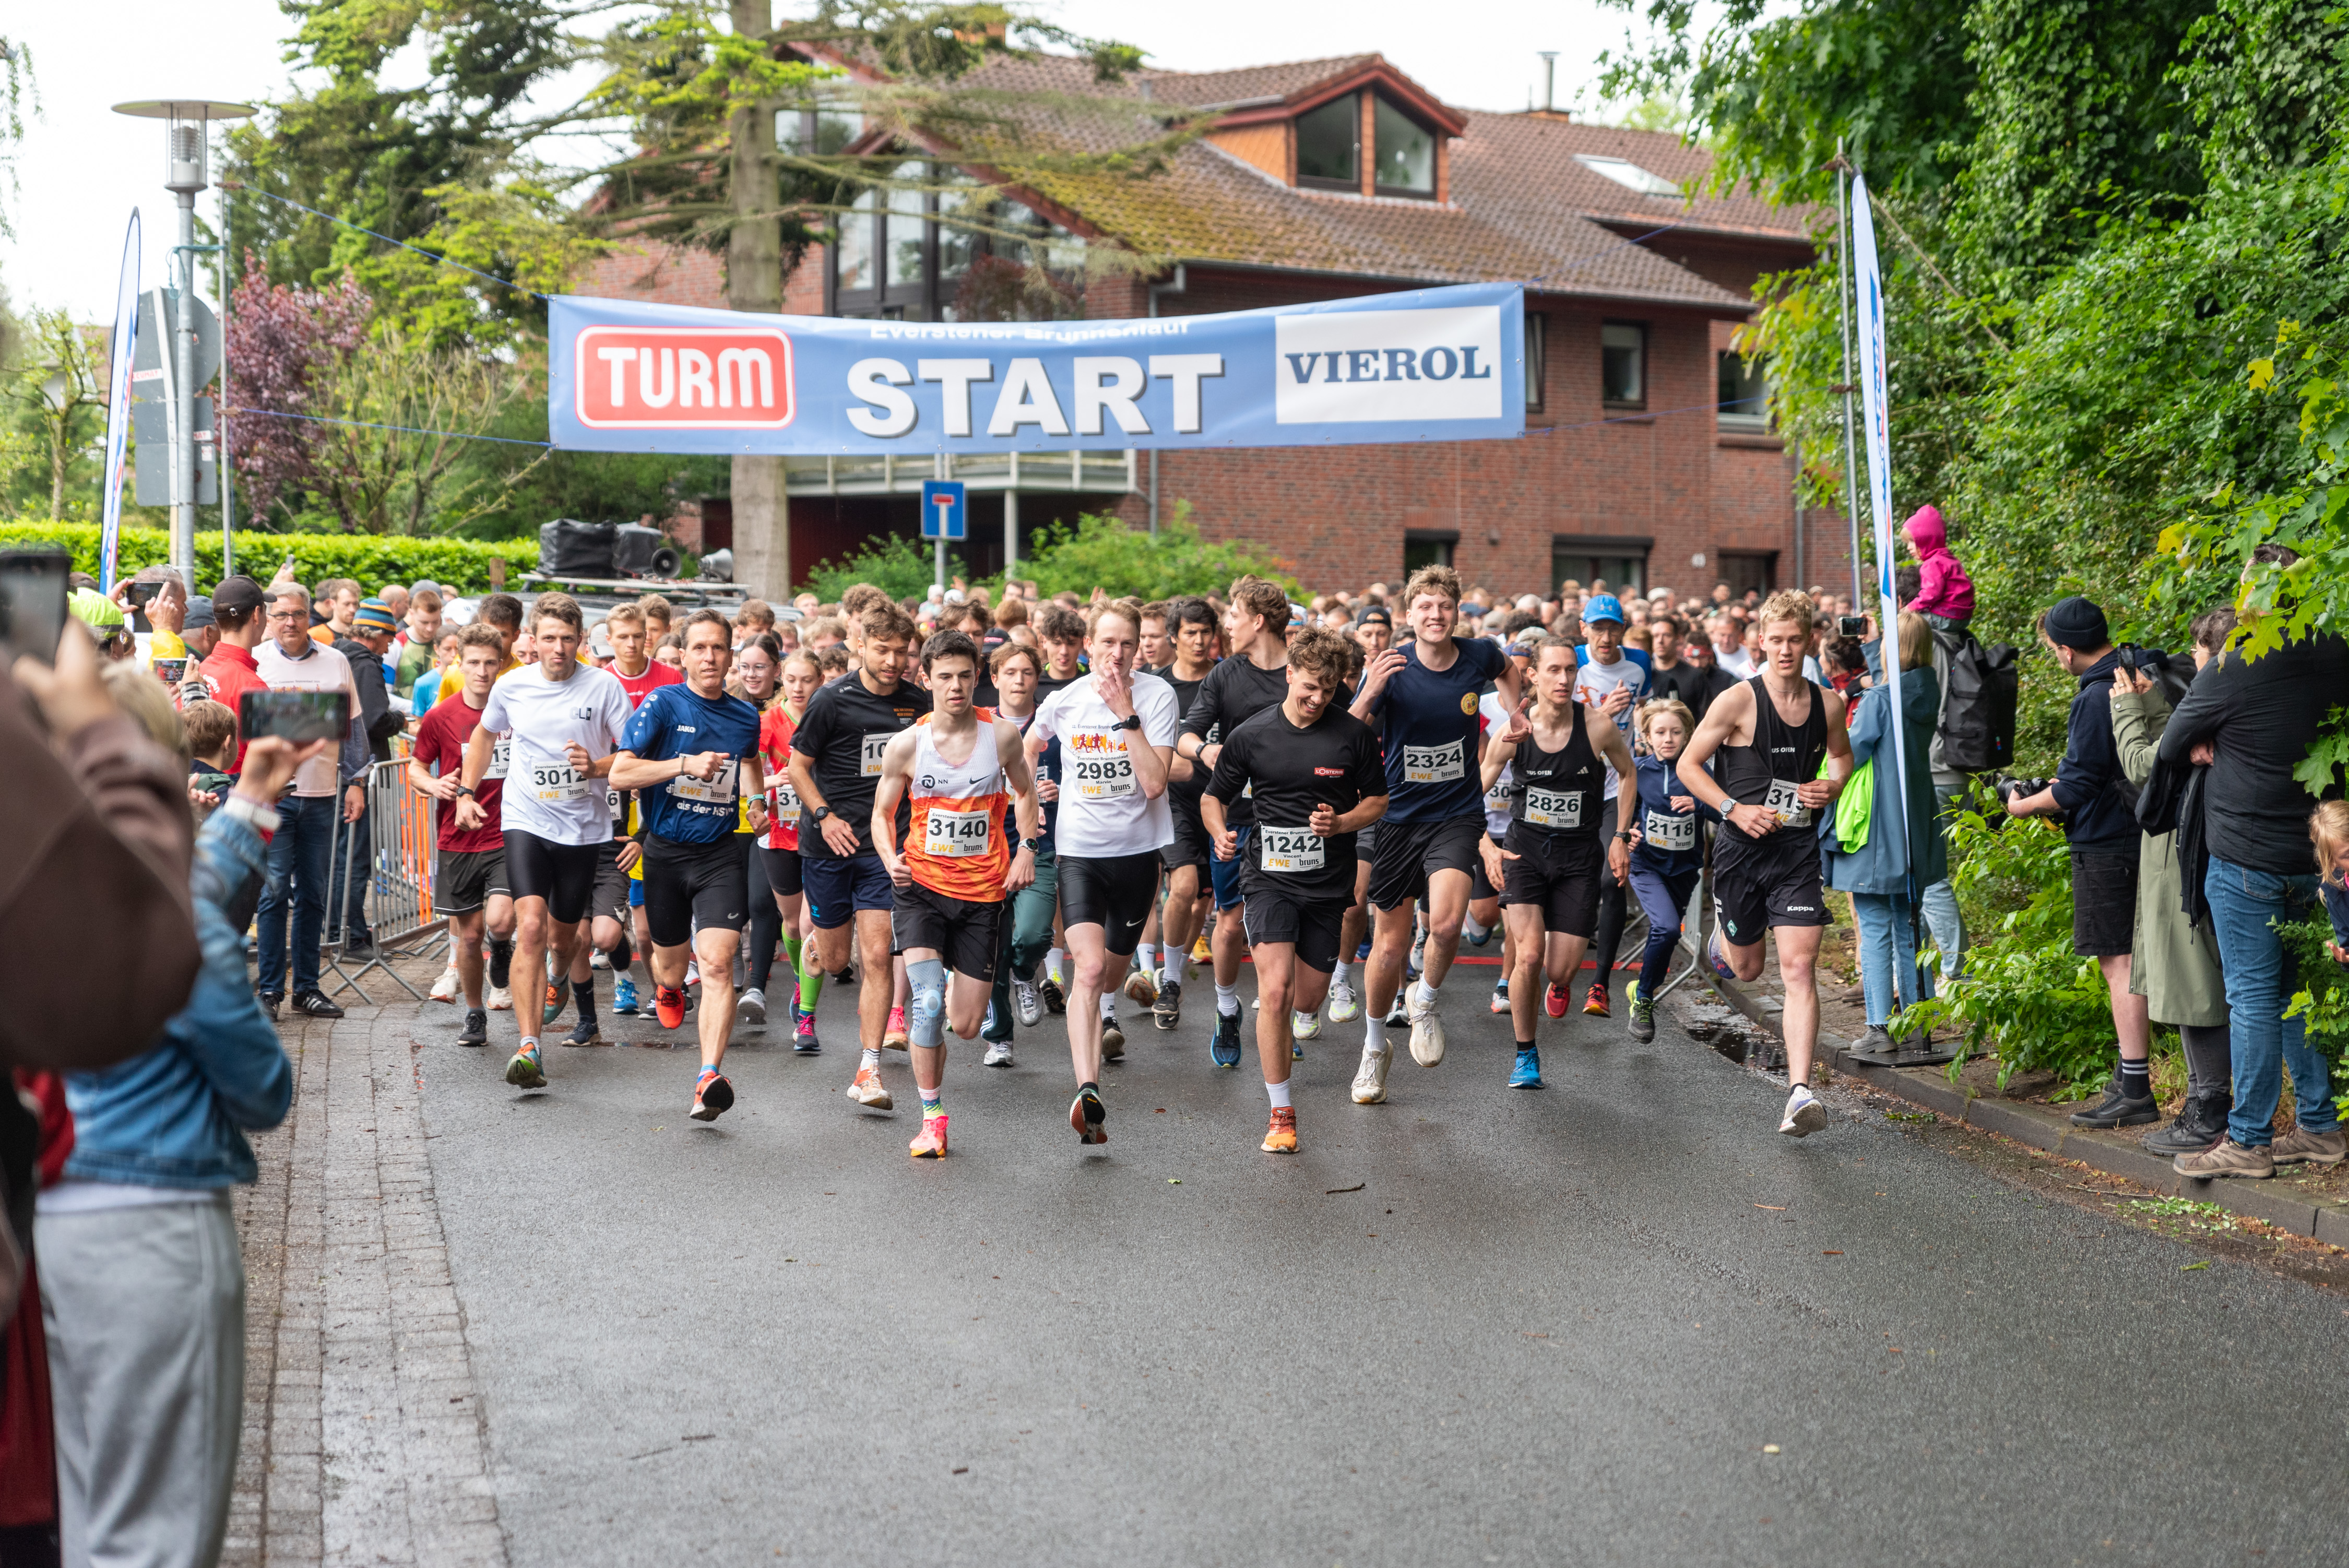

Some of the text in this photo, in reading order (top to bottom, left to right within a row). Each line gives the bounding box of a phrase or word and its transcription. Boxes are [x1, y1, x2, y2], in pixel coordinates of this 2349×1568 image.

[870, 324, 1017, 339] Everstener
[1285, 345, 1491, 384] VIEROL
[597, 346, 774, 409] TURM
[846, 353, 1224, 438] START
[677, 724, 696, 733] JAKO
[1433, 744, 1459, 753] Brunnenlauf
[1406, 748, 1462, 768] 2324
[867, 764, 882, 773] EW
[1076, 760, 1132, 779] 2983
[1441, 769, 1460, 777] bruns
[534, 768, 587, 786] 3012
[679, 785, 703, 797] EWE
[710, 790, 727, 798] bruns
[1082, 786, 1102, 794] EWE
[1110, 783, 1131, 792] bruns
[1489, 786, 1510, 798] 30
[778, 792, 800, 806] 31
[1528, 793, 1580, 813] 2826
[677, 800, 691, 811] als
[692, 803, 711, 814] der
[1530, 813, 1550, 823] EWE
[1775, 813, 1790, 823] WE
[929, 818, 987, 838] 3140
[1648, 819, 1693, 837] 2118
[931, 842, 955, 853] EWE
[1264, 835, 1322, 853] 1242
[1650, 837, 1668, 846] EWE
[1268, 858, 1290, 868] EWE
